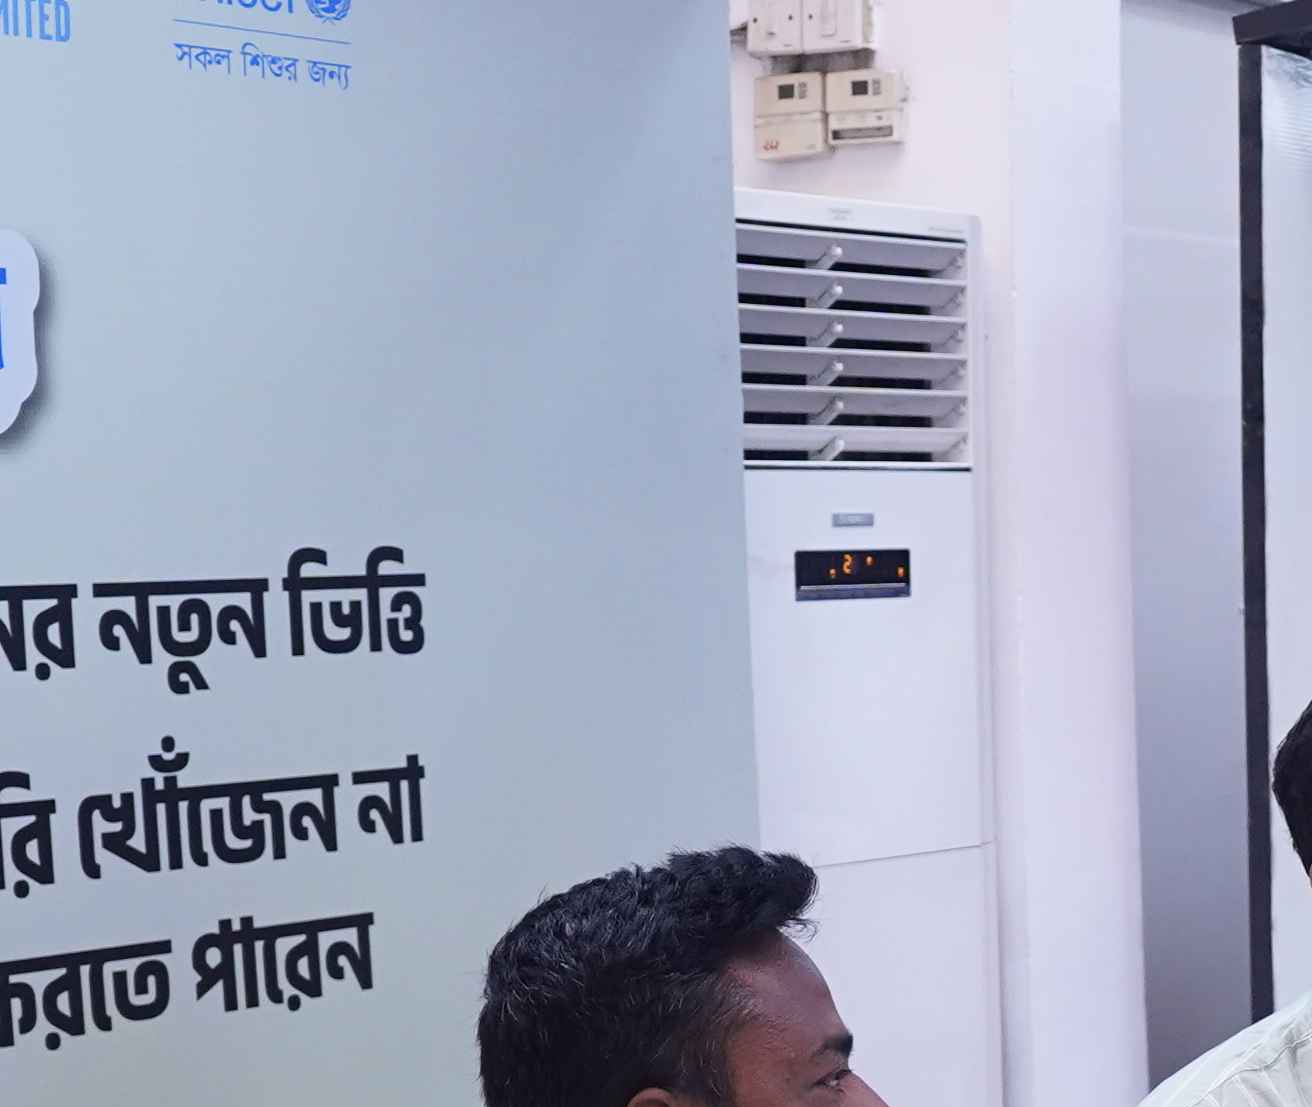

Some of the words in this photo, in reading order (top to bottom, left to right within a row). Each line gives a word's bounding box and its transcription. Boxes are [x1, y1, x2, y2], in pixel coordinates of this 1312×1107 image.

[173, 43, 232, 75] সকল
[240, 42, 299, 82] শিশুর
[306, 59, 352, 90] জন্য
[93, 577, 269, 695] নতুন
[282, 545, 426, 657] ভিত্তি
[78, 735, 339, 880] খোঁজেন
[352, 754, 425, 845] না
[191, 912, 374, 1012] পারেন
